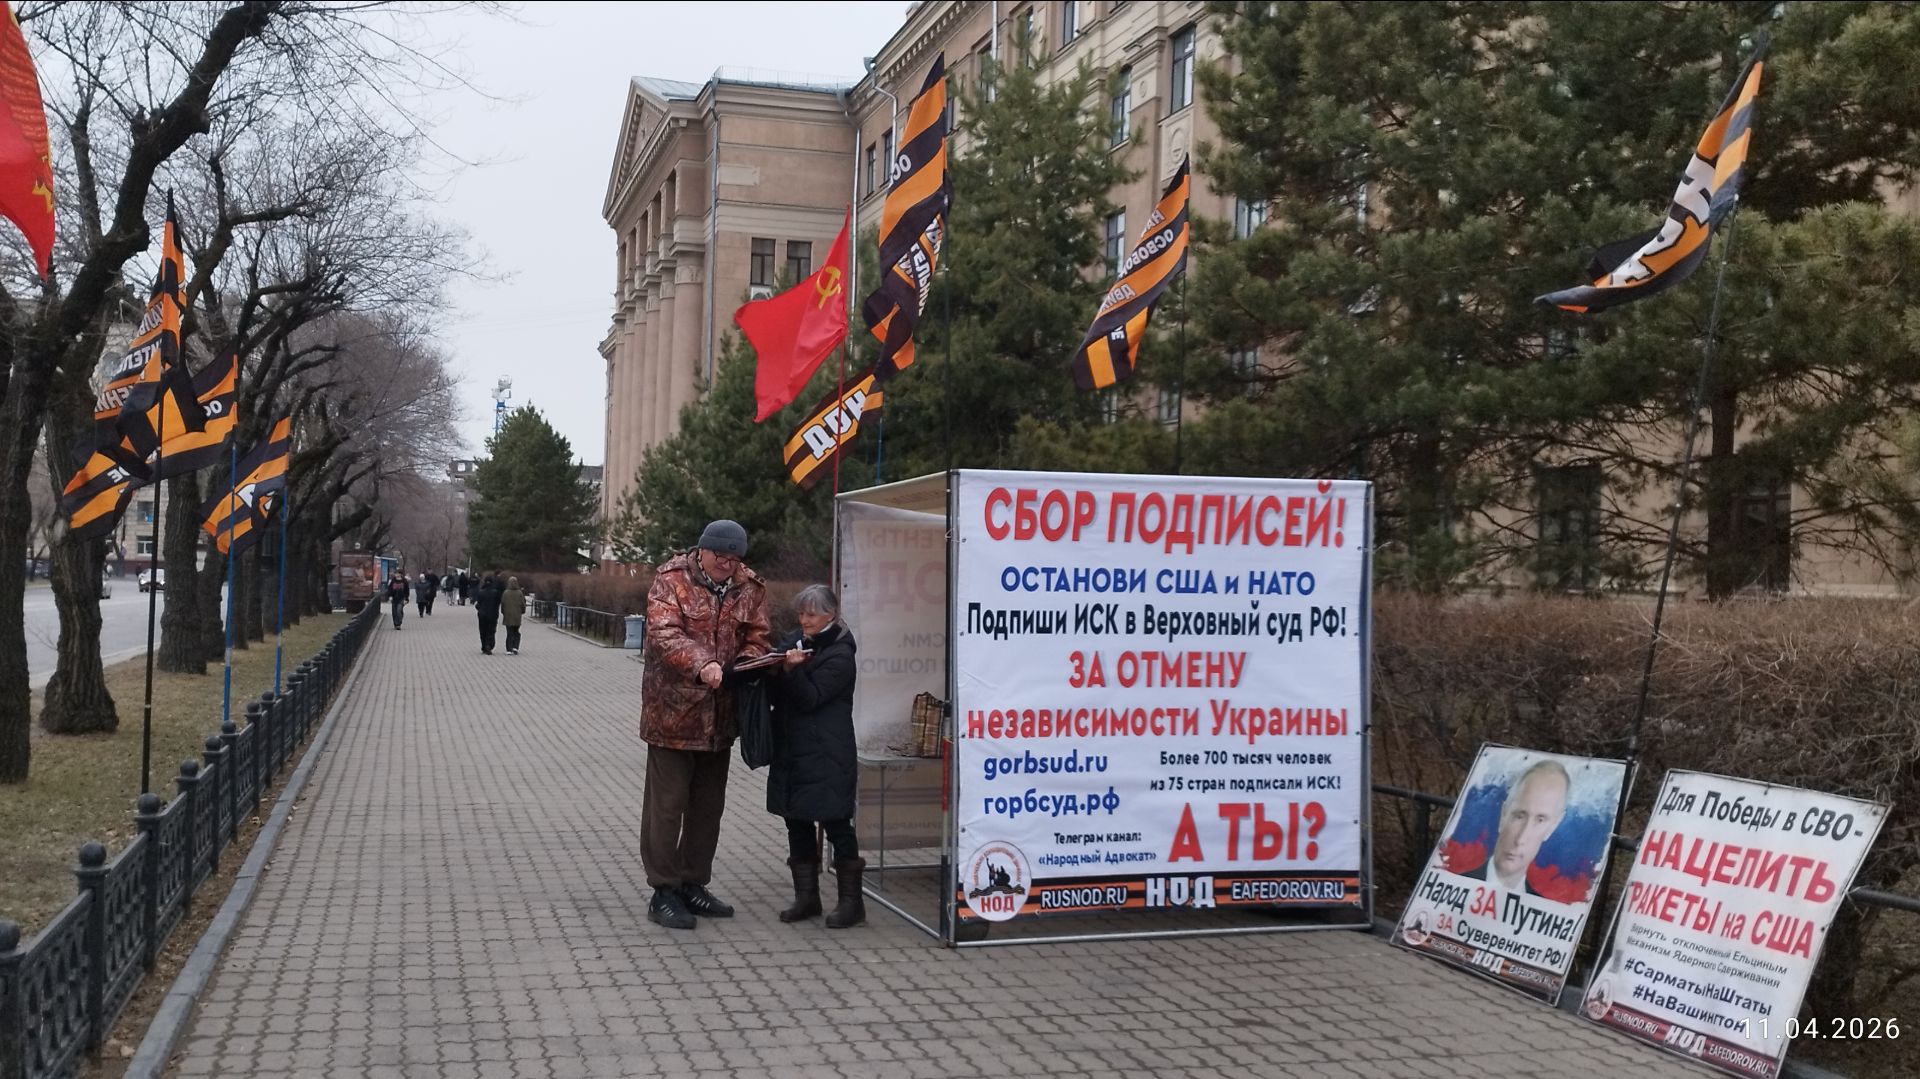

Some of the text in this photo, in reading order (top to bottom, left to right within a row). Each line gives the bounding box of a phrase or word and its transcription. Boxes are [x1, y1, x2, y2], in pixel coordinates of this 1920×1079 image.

[984, 480, 1346, 554] СБОР ПОДПИСЕЙ!
[1001, 566, 1316, 595] ОСТАНОВИ США и НАТО
[967, 600, 1347, 645] Подпиши ИСК в Верховный суд РФ!
[1069, 650, 1247, 689] ЗА ОТМЕНУ
[967, 699, 1348, 745] независимости Украины
[983, 749, 1108, 780] gorbsud.ru
[1160, 750, 1332, 767] Более 700 тысяч человек
[1150, 776, 1342, 793] из 75 стран подписали ИСК!
[983, 787, 1120, 819] горбсуд.рф
[1659, 786, 1696, 815] Для
[1700, 790, 1780, 832] Победы
[1782, 811, 1796, 832] в
[1054, 831, 1142, 846] Телеграм канал:
[1168, 801, 1327, 862] А ТЫ?
[1038, 850, 1157, 867] «Народный Адвокат»
[1640, 828, 1837, 905] НАЦЕЛИТЬ
[980, 895, 1015, 913] НОД
[1041, 887, 1127, 909] RUSNOD.RU
[1145, 876, 1216, 909] НОД
[1231, 880, 1345, 901] EAFEDOROV.RU
[1418, 871, 1585, 943] Народ ЗА Путина!
[1626, 880, 1815, 959] РАКЕТЫ на США
[1436, 913, 1569, 969] ЗА Суверенитет РФ!
[1672, 950, 1716, 972] Ядерного
[1717, 962, 1781, 989] Сдерживания
[1732, 951, 1789, 975] Ельциным
[1624, 957, 1773, 1016] #СарматыНаШтаты
[1664, 1025, 1708, 1057] НОД
